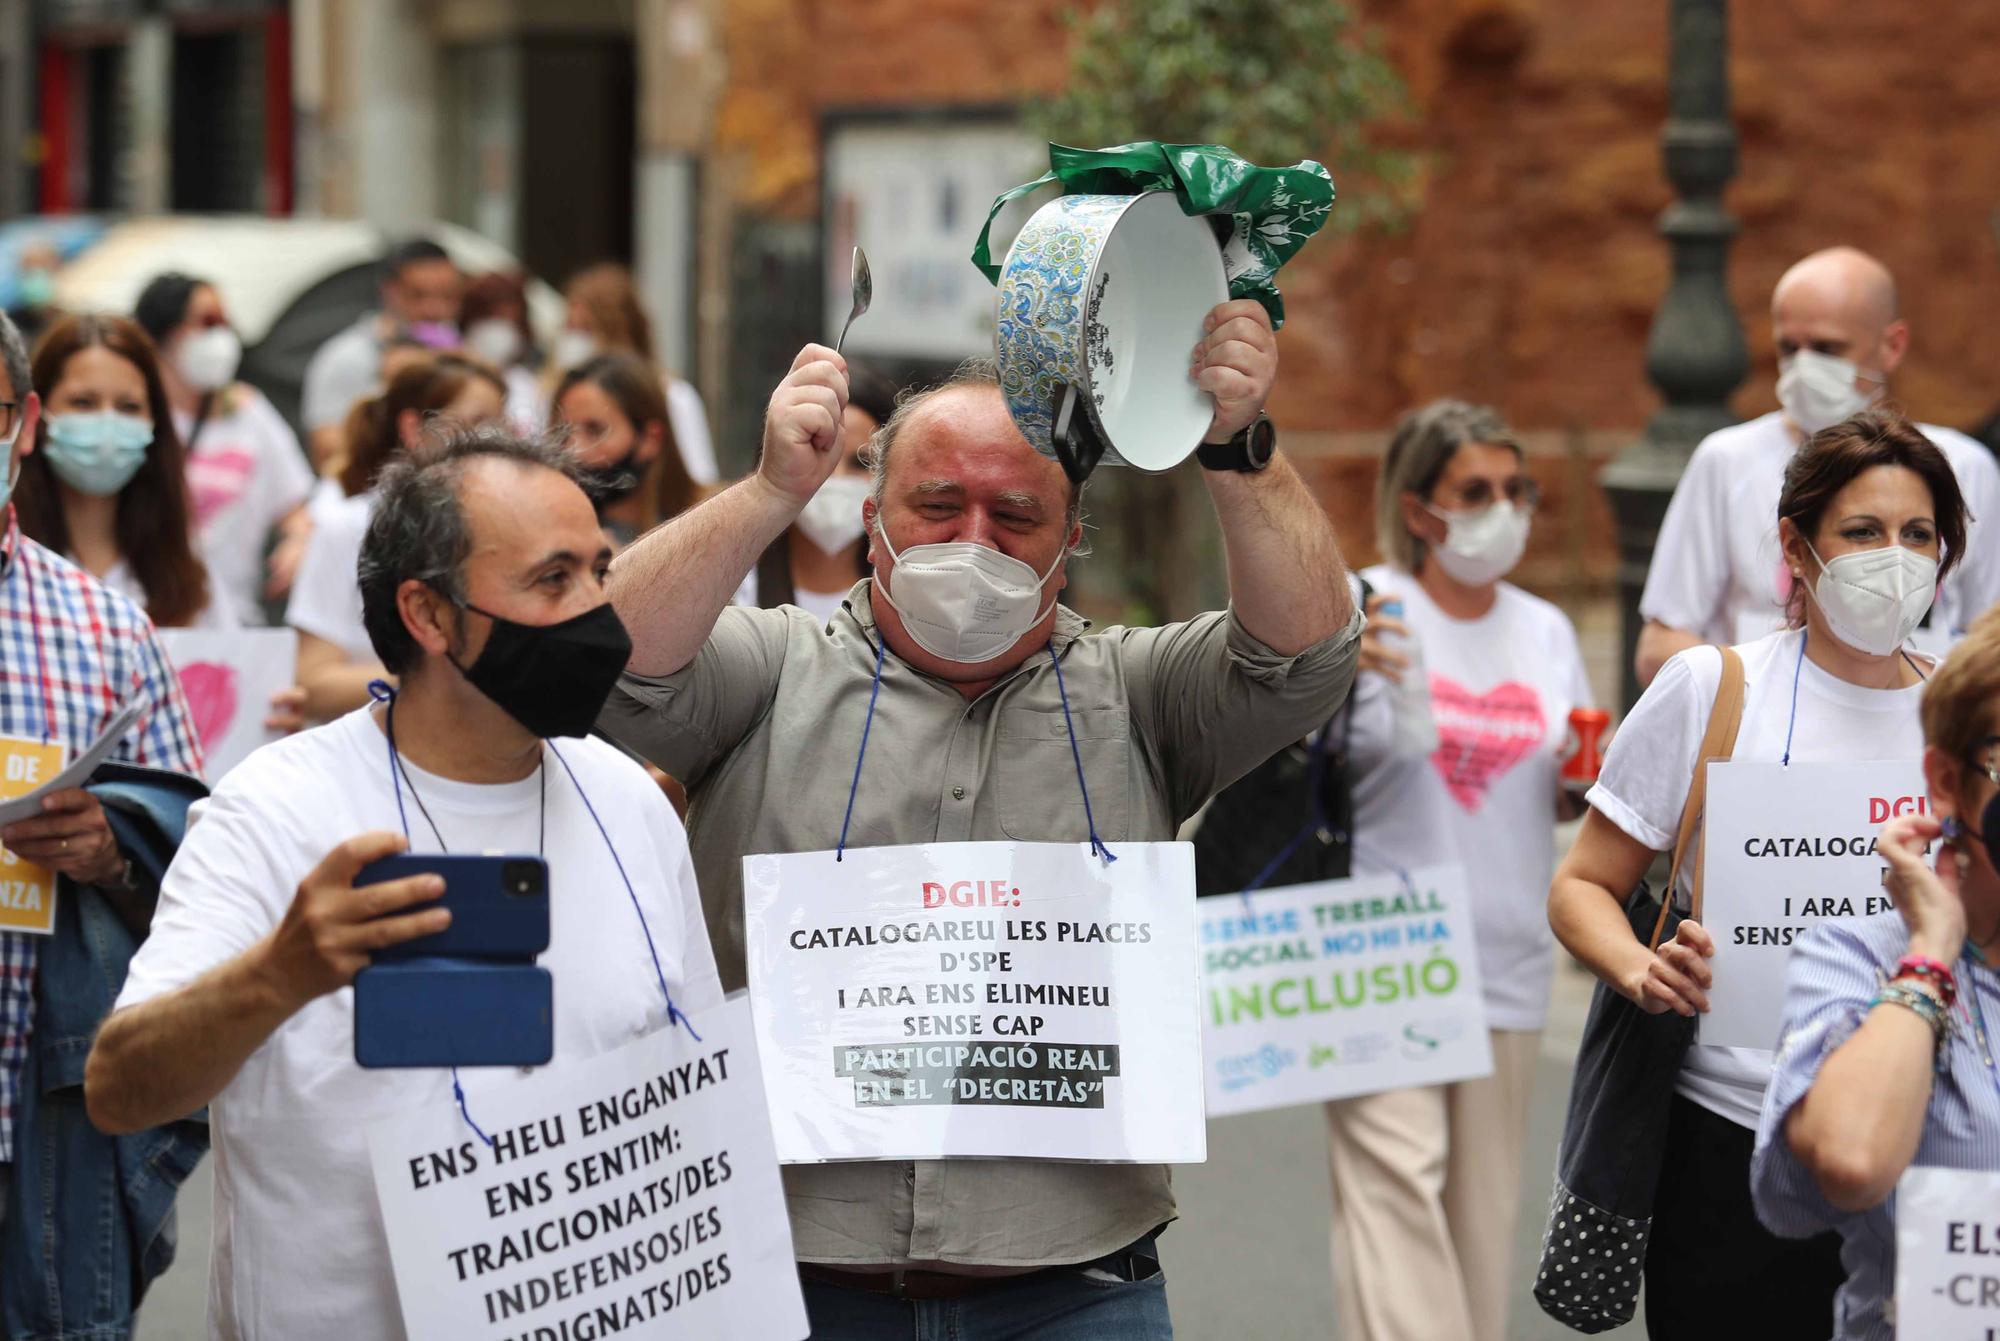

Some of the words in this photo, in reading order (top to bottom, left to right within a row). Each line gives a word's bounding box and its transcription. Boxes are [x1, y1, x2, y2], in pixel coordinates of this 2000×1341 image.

[7, 753, 40, 784] DE
[1869, 796, 1929, 823] DGI
[1743, 837, 1931, 858] CATALOGA
[922, 880, 1021, 909] DGIE:
[1784, 898, 1791, 916] I
[1801, 898, 1855, 916] ARA
[1865, 897, 1896, 915] EN
[1201, 911, 1298, 943] SENSE
[1311, 890, 1444, 926] TREBALL
[790, 920, 994, 950] CATALOGAREU
[1006, 920, 1047, 942] LES
[1057, 922, 1152, 944] PLACES
[1205, 940, 1314, 974] SOCIAL
[1322, 931, 1365, 956] NO
[1407, 921, 1450, 943] HA
[940, 951, 1013, 973] D'SPE
[838, 989, 846, 1009] I
[856, 985, 916, 1009] ARA
[926, 983, 975, 1005] ENS
[986, 983, 1110, 1007] ELIMINEU
[1211, 945, 1459, 1026] INCLUSIÓ
[904, 1015, 982, 1037] SENSE
[993, 1015, 1044, 1036] CAP
[845, 1042, 1038, 1071] PARTICIPACIÓ
[1047, 1048, 1111, 1072] REAL
[856, 1081, 892, 1102] EN
[904, 1079, 934, 1100] EL
[409, 1141, 477, 1190] ENS
[491, 1115, 565, 1165] HEU
[578, 1048, 730, 1138] ENGANYAT
[485, 1171, 552, 1219] ENS
[565, 1124, 682, 1193] SENTIM:
[448, 1151, 732, 1281] TRAICIONATS/DES
[1948, 1222, 2000, 1256] EL
[485, 1206, 722, 1323] INDEFENSOS/ES
